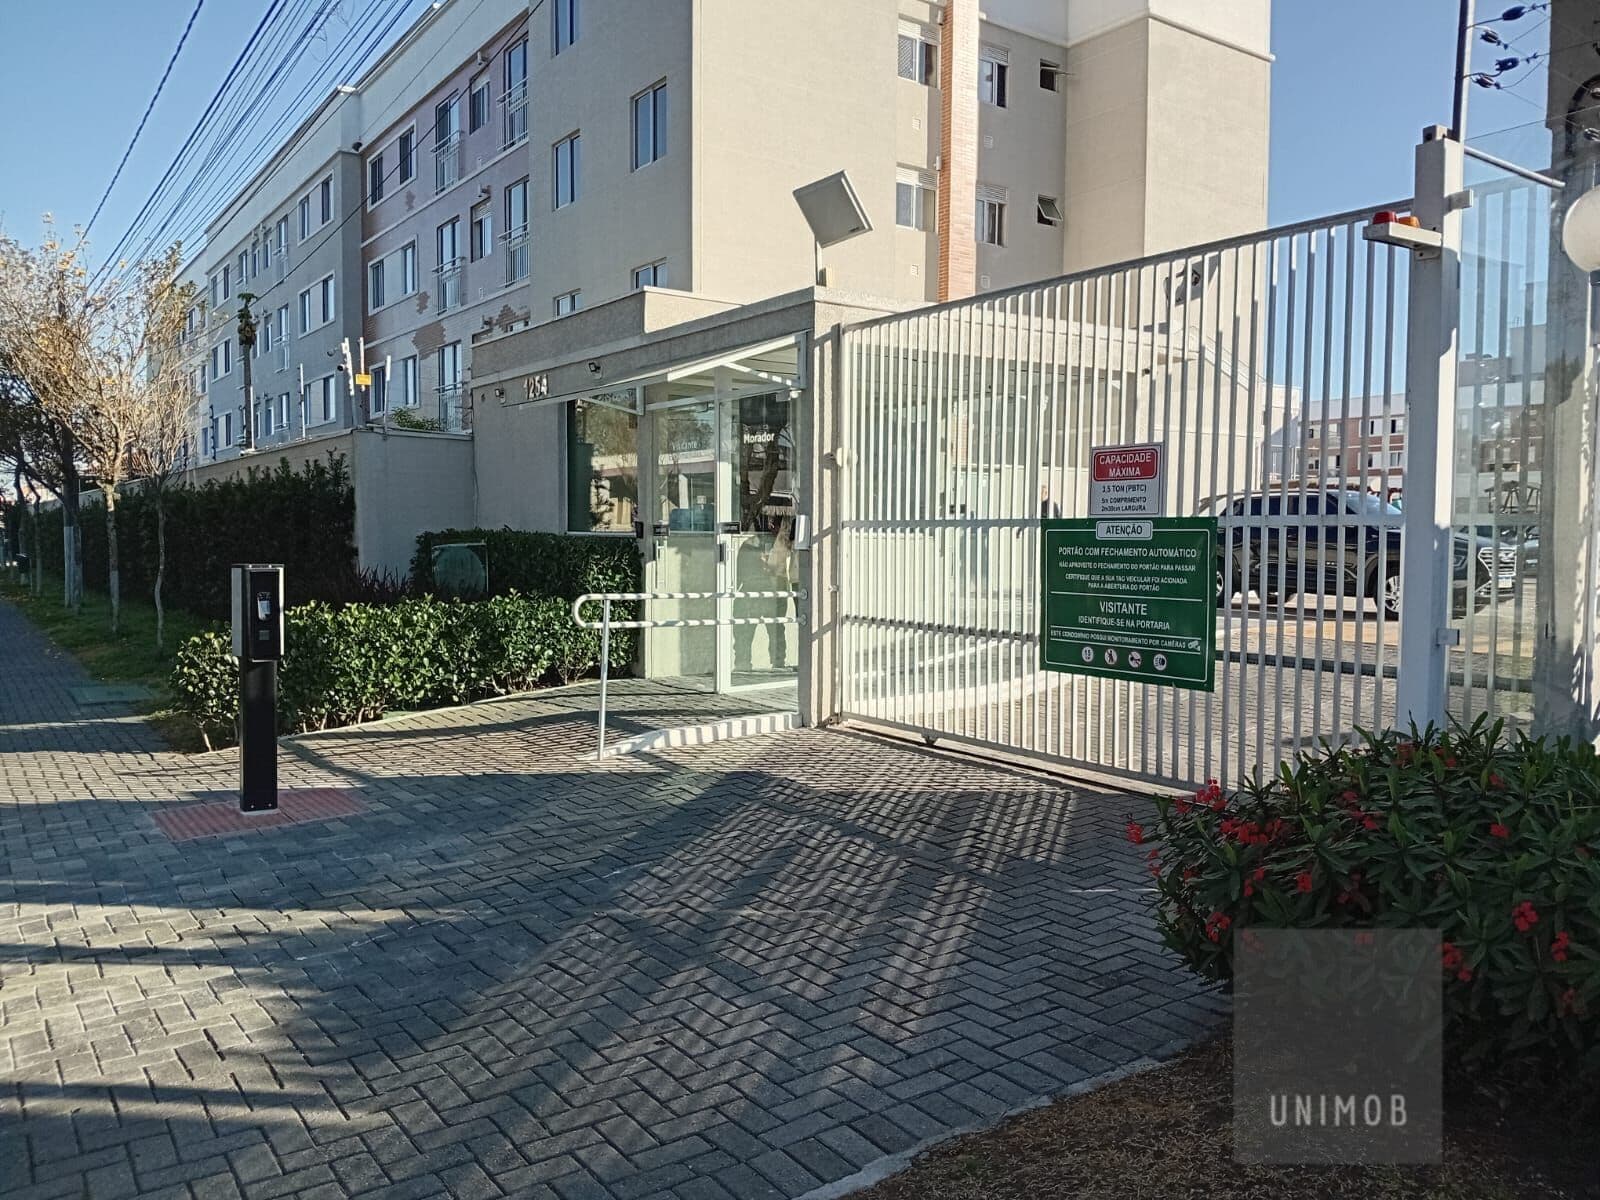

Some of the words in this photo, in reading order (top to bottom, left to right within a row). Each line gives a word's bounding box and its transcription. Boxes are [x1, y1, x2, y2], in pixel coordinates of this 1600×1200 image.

[523, 374, 548, 399] 1254
[743, 432, 775, 444] Morador
[1099, 452, 1152, 465] CAPACIDADE
[1112, 484, 1125, 492] TON
[1105, 523, 1143, 536] ATENÇÃO
[1058, 545, 1084, 556] PORTÃO
[1084, 547, 1100, 556] COM
[1100, 547, 1148, 557] FECHAMENTO
[1148, 547, 1197, 558] AUTOMÁTICO
[1098, 562, 1130, 570] FECHAMENTO
[1139, 562, 1160, 571] PORTÃO
[1174, 564, 1197, 572] PASSAR
[1160, 577, 1188, 585] ACIONADA
[1138, 584, 1160, 592] PORTÃO
[1100, 601, 1148, 616] VISITANTE
[1078, 616, 1125, 627] IDENTIFIQUE-SE
[1125, 619, 1136, 628] NA
[1135, 620, 1171, 630] PORTARIA
